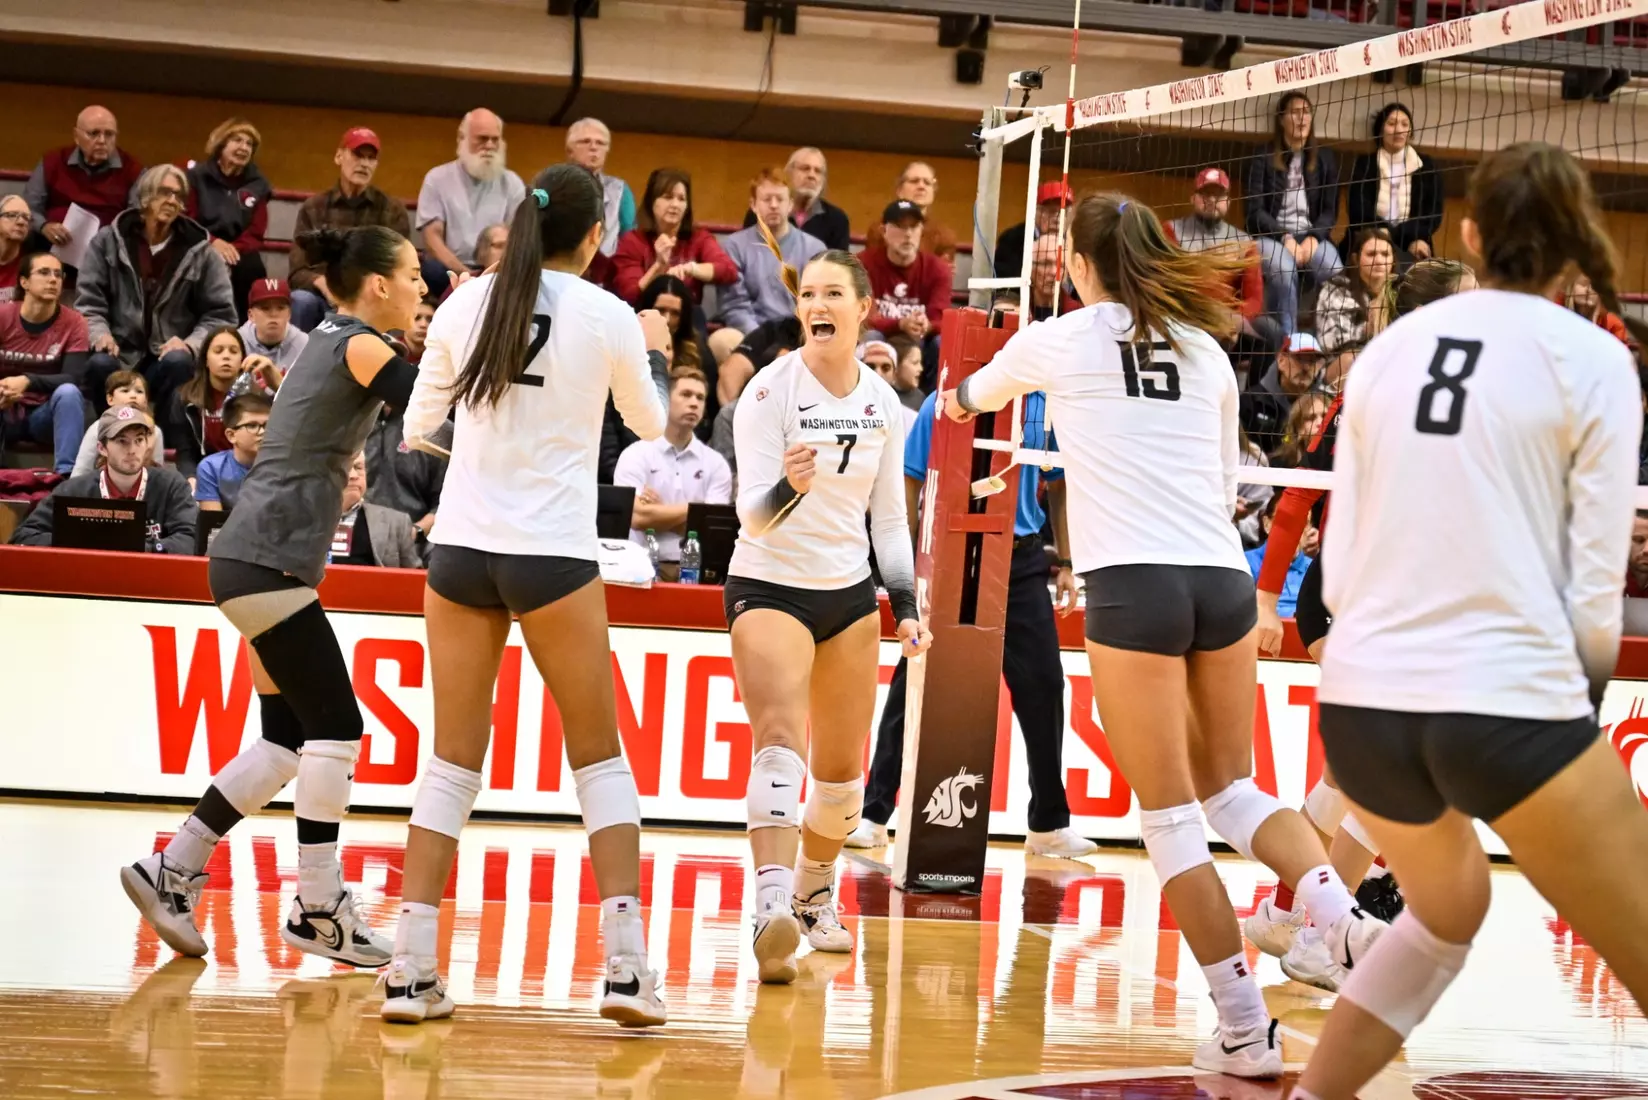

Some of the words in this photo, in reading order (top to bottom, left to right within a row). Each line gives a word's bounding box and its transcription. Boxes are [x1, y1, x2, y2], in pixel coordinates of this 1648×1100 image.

[1448, 18, 1472, 47] STATE
[265, 279, 278, 291] W
[507, 314, 552, 387] 2
[1116, 340, 1181, 401] 15
[1415, 337, 1483, 435] 8
[800, 418, 859, 430] WASHINGTON
[835, 434, 857, 474] 7
[918, 872, 943, 882] sports
